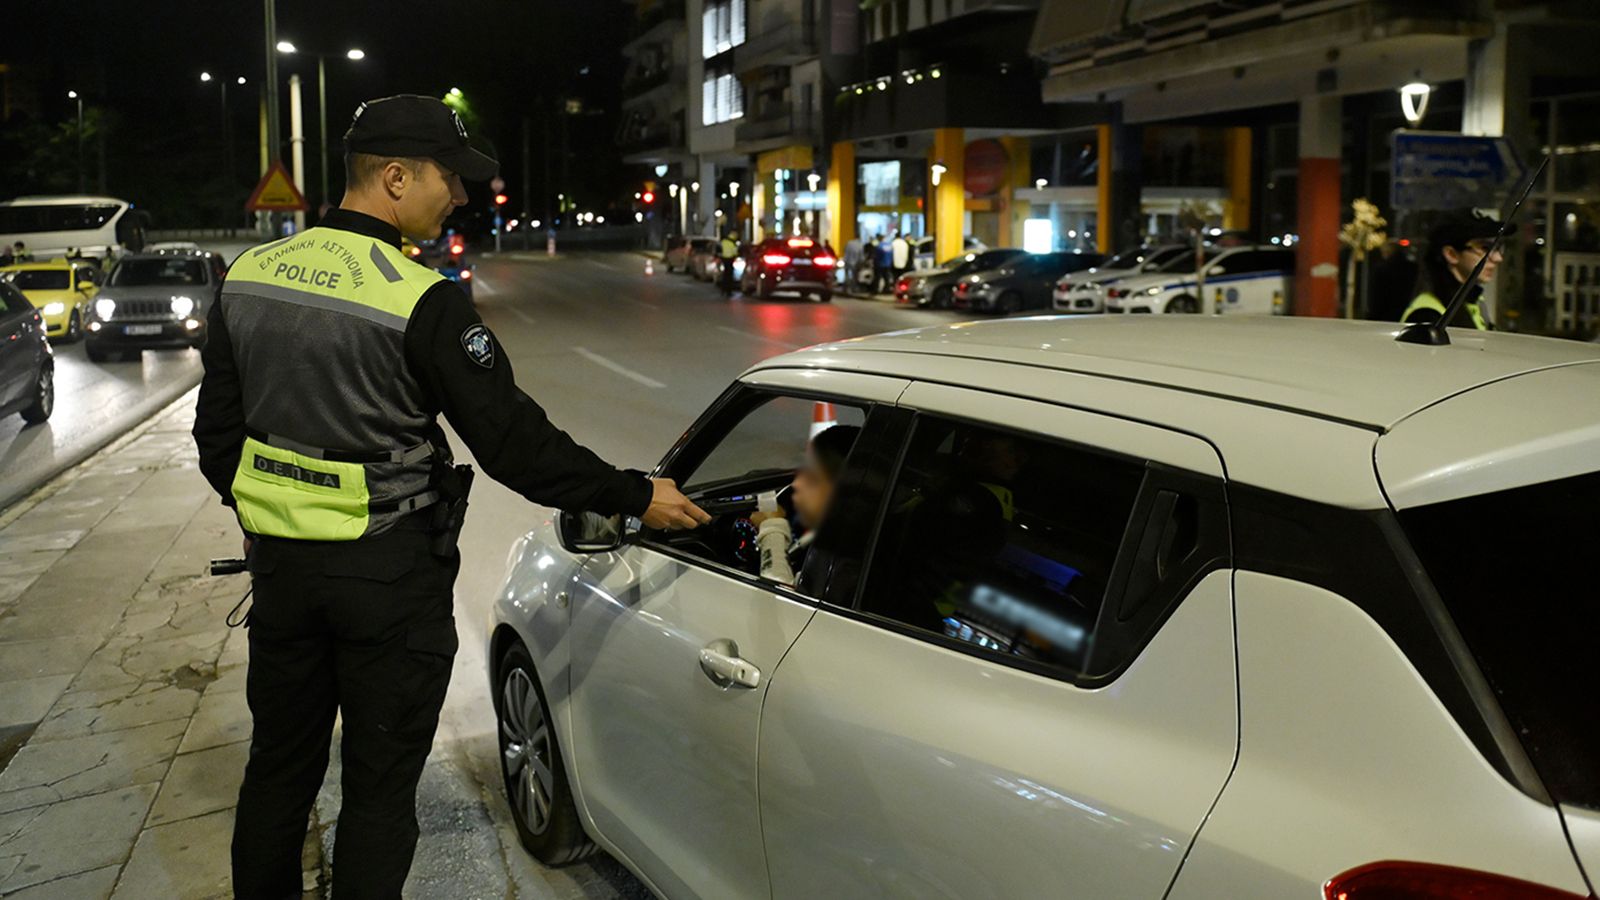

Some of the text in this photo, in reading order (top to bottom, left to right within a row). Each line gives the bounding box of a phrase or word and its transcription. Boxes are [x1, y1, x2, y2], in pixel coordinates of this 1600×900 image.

[259, 239, 365, 290] ΕΛΛΗΝΙΚΗ ΑΣΤΥΝΟΜΙΑ
[273, 262, 342, 289] POLICE
